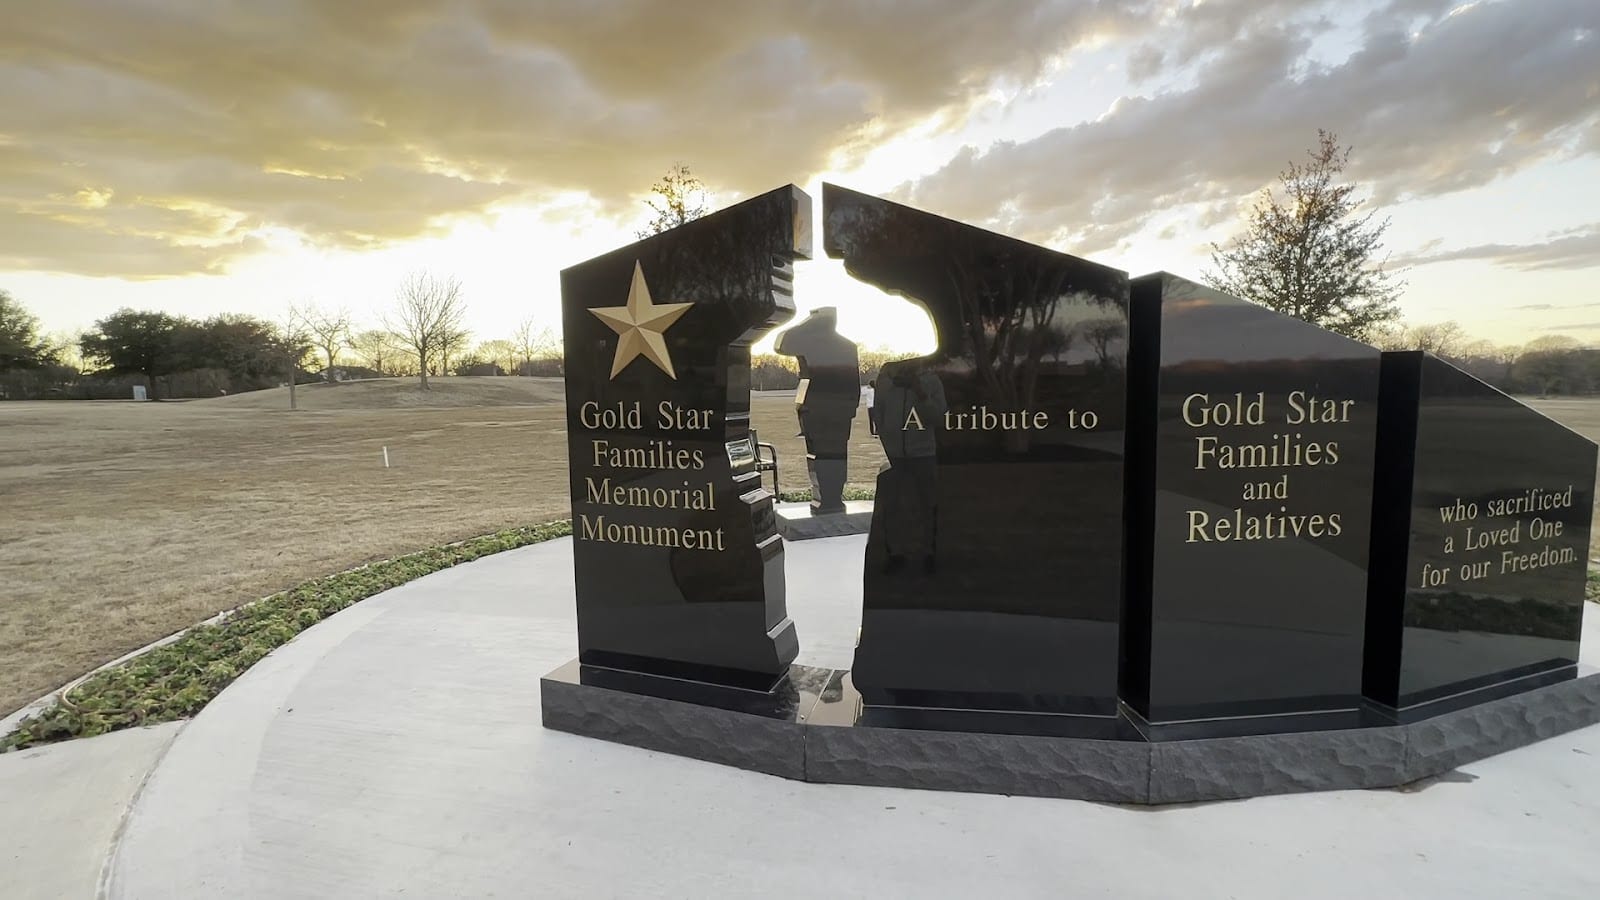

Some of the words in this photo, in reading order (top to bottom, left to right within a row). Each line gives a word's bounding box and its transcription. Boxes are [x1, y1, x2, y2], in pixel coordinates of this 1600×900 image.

[580, 401, 642, 430] Gold
[658, 400, 714, 430] Star
[902, 406, 924, 431] A
[944, 405, 1048, 431] tribute
[1068, 408, 1098, 429] to
[1182, 391, 1265, 427] Gold
[1286, 390, 1355, 425] Star
[593, 440, 704, 470] Families
[1194, 433, 1338, 470] Families
[585, 477, 715, 511] Memorial
[1242, 474, 1288, 501] and
[1439, 498, 1478, 524] who
[1487, 485, 1573, 517] sacrificed
[579, 514, 725, 551] Monument
[1185, 506, 1342, 543] Relatives
[1443, 535, 1454, 554] a
[1465, 520, 1521, 551] Loved
[1529, 517, 1563, 540] One
[1421, 563, 1451, 588] for
[1460, 561, 1491, 581] our
[1500, 545, 1578, 575] Freedom.
